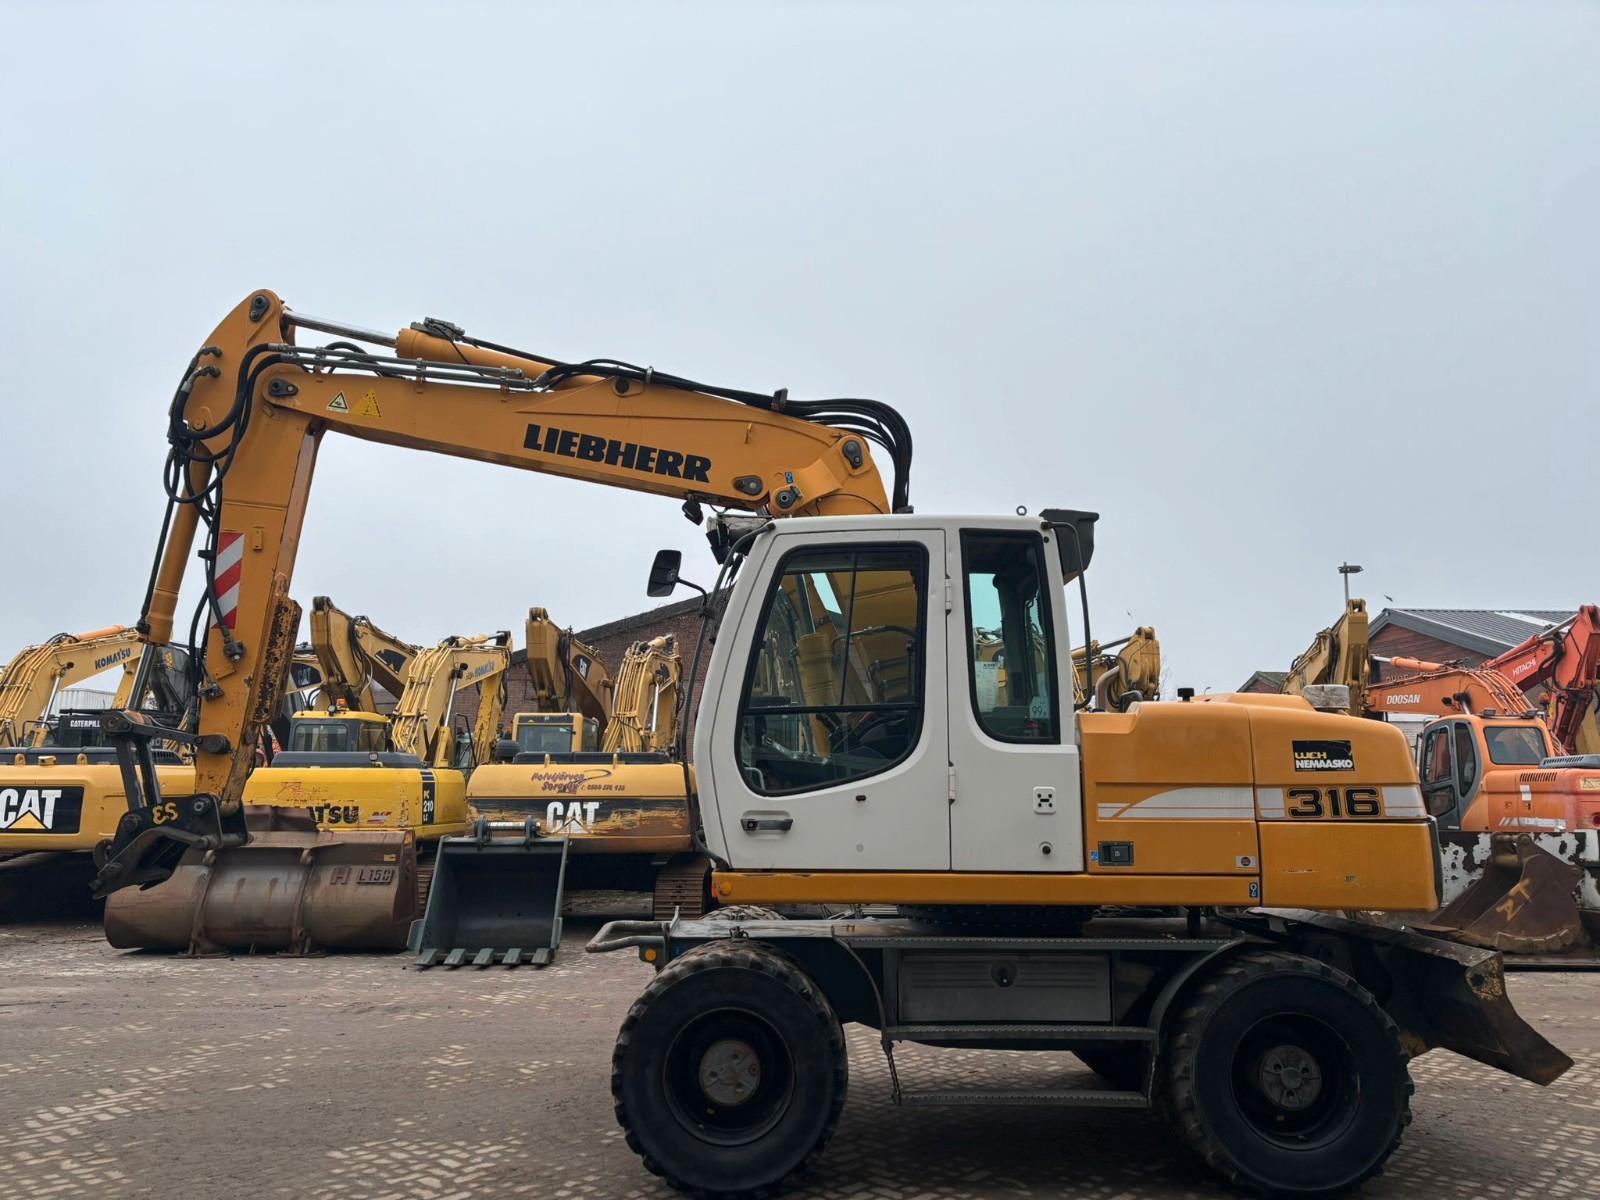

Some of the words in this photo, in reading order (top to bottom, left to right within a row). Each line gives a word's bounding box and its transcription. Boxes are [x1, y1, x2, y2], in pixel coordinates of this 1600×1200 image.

[523, 423, 712, 483] LIEBHERR
[95, 647, 131, 670] KOMATSU
[1512, 657, 1536, 675] HITACHI
[1386, 694, 1421, 705] DOOSAN
[1296, 759, 1353, 769] NEMAASKO
[0, 788, 62, 829] CAT
[423, 800, 434, 812] 210
[1287, 787, 1381, 817] 316
[546, 801, 600, 832] CAT
